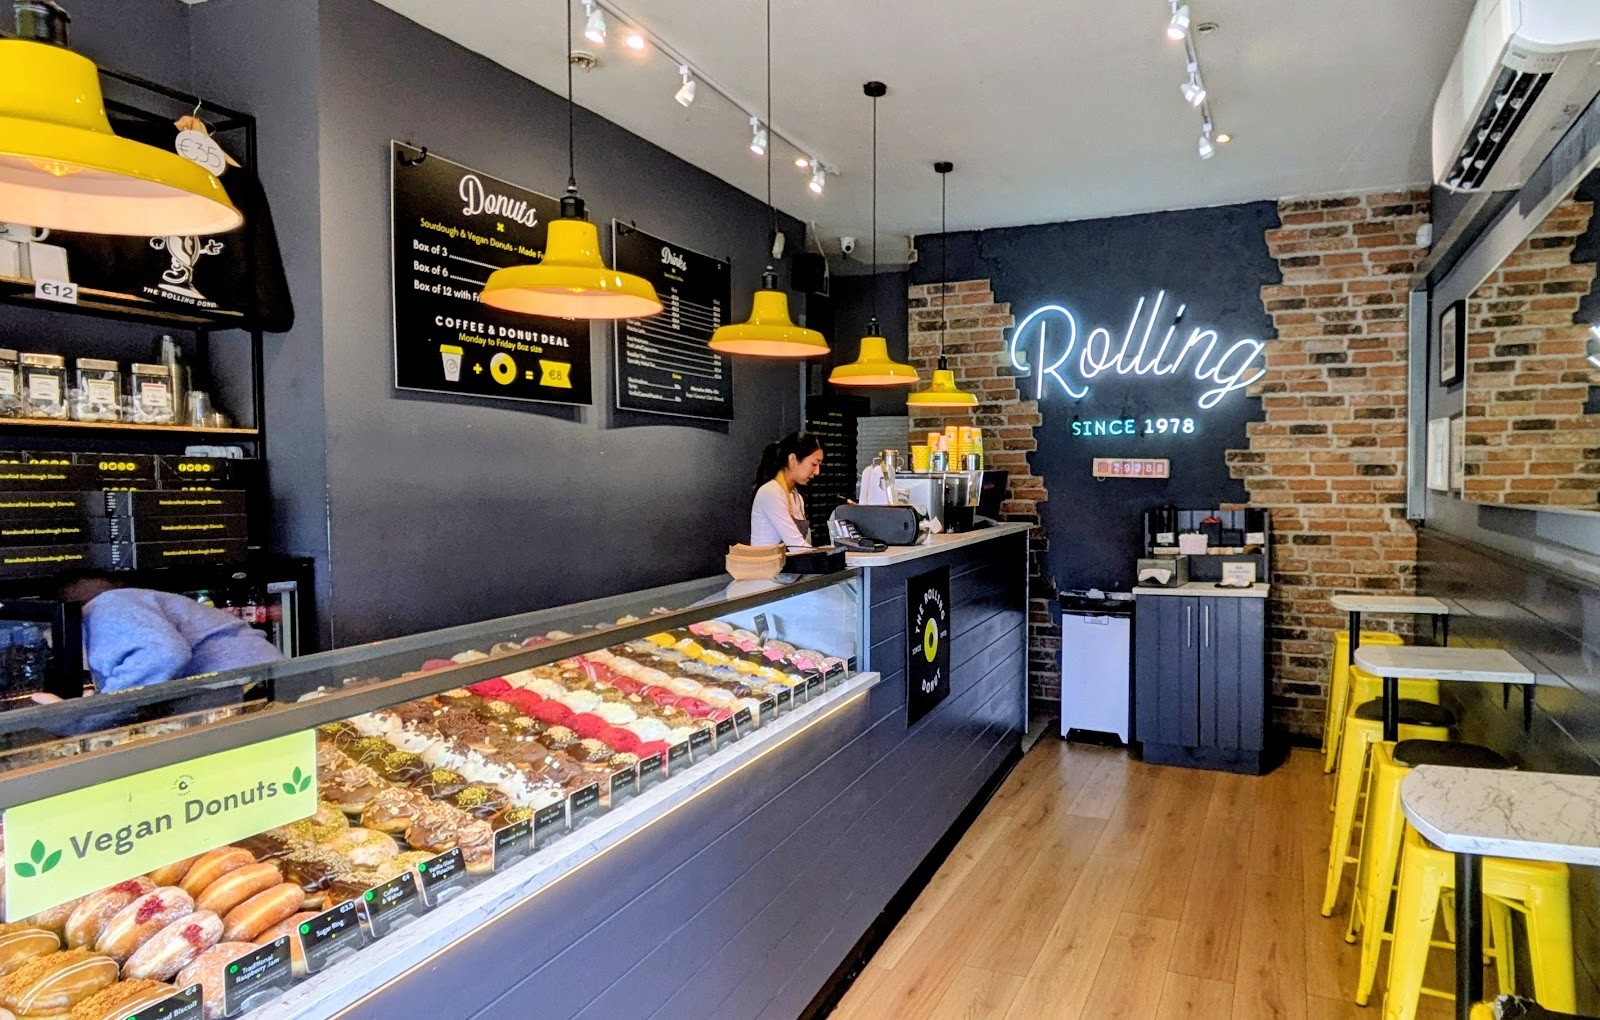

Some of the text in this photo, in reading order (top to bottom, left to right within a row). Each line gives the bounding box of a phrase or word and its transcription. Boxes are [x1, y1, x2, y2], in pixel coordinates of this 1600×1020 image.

[177, 138, 221, 168] €35
[459, 175, 539, 227] Donuts
[413, 238, 448, 257] Box of 3
[420, 217, 459, 238] Sourdough
[459, 229, 466, 238] &
[467, 231, 489, 245] Vegan
[490, 237, 513, 251] Donuts
[518, 245, 537, 258] Made
[413, 260, 449, 277] Box of 6
[660, 246, 687, 271] Drinks
[41, 282, 74, 299] €12
[143, 286, 159, 295] THE
[161, 291, 195, 305] ROLLING
[413, 279, 430, 292] Box
[431, 283, 442, 294] of
[442, 286, 453, 297] 12
[453, 289, 471, 300] with
[435, 315, 571, 347] COFFEE & DONUT DEAL
[458, 332, 486, 347] Monday
[487, 338, 495, 346] to
[496, 339, 516, 351] Friday
[1010, 289, 1267, 410] Rolling
[548, 370, 562, 381] €8
[1071, 417, 1196, 437] SINCE 1978
[915, 588, 946, 633] THE ROLLING
[921, 667, 941, 693] DONUT
[69, 812, 173, 859] Vegan
[185, 779, 278, 824] Donuts
[383, 886, 400, 897] Coffee
[315, 919, 345, 937] Sugar Ring
[274, 938, 285, 947] €4
[236, 957, 280, 984] Raspberry Jam
[242, 953, 273, 973] Traditional
[185, 985, 197, 996] €4
[173, 1000, 198, 1017] Biscuit
